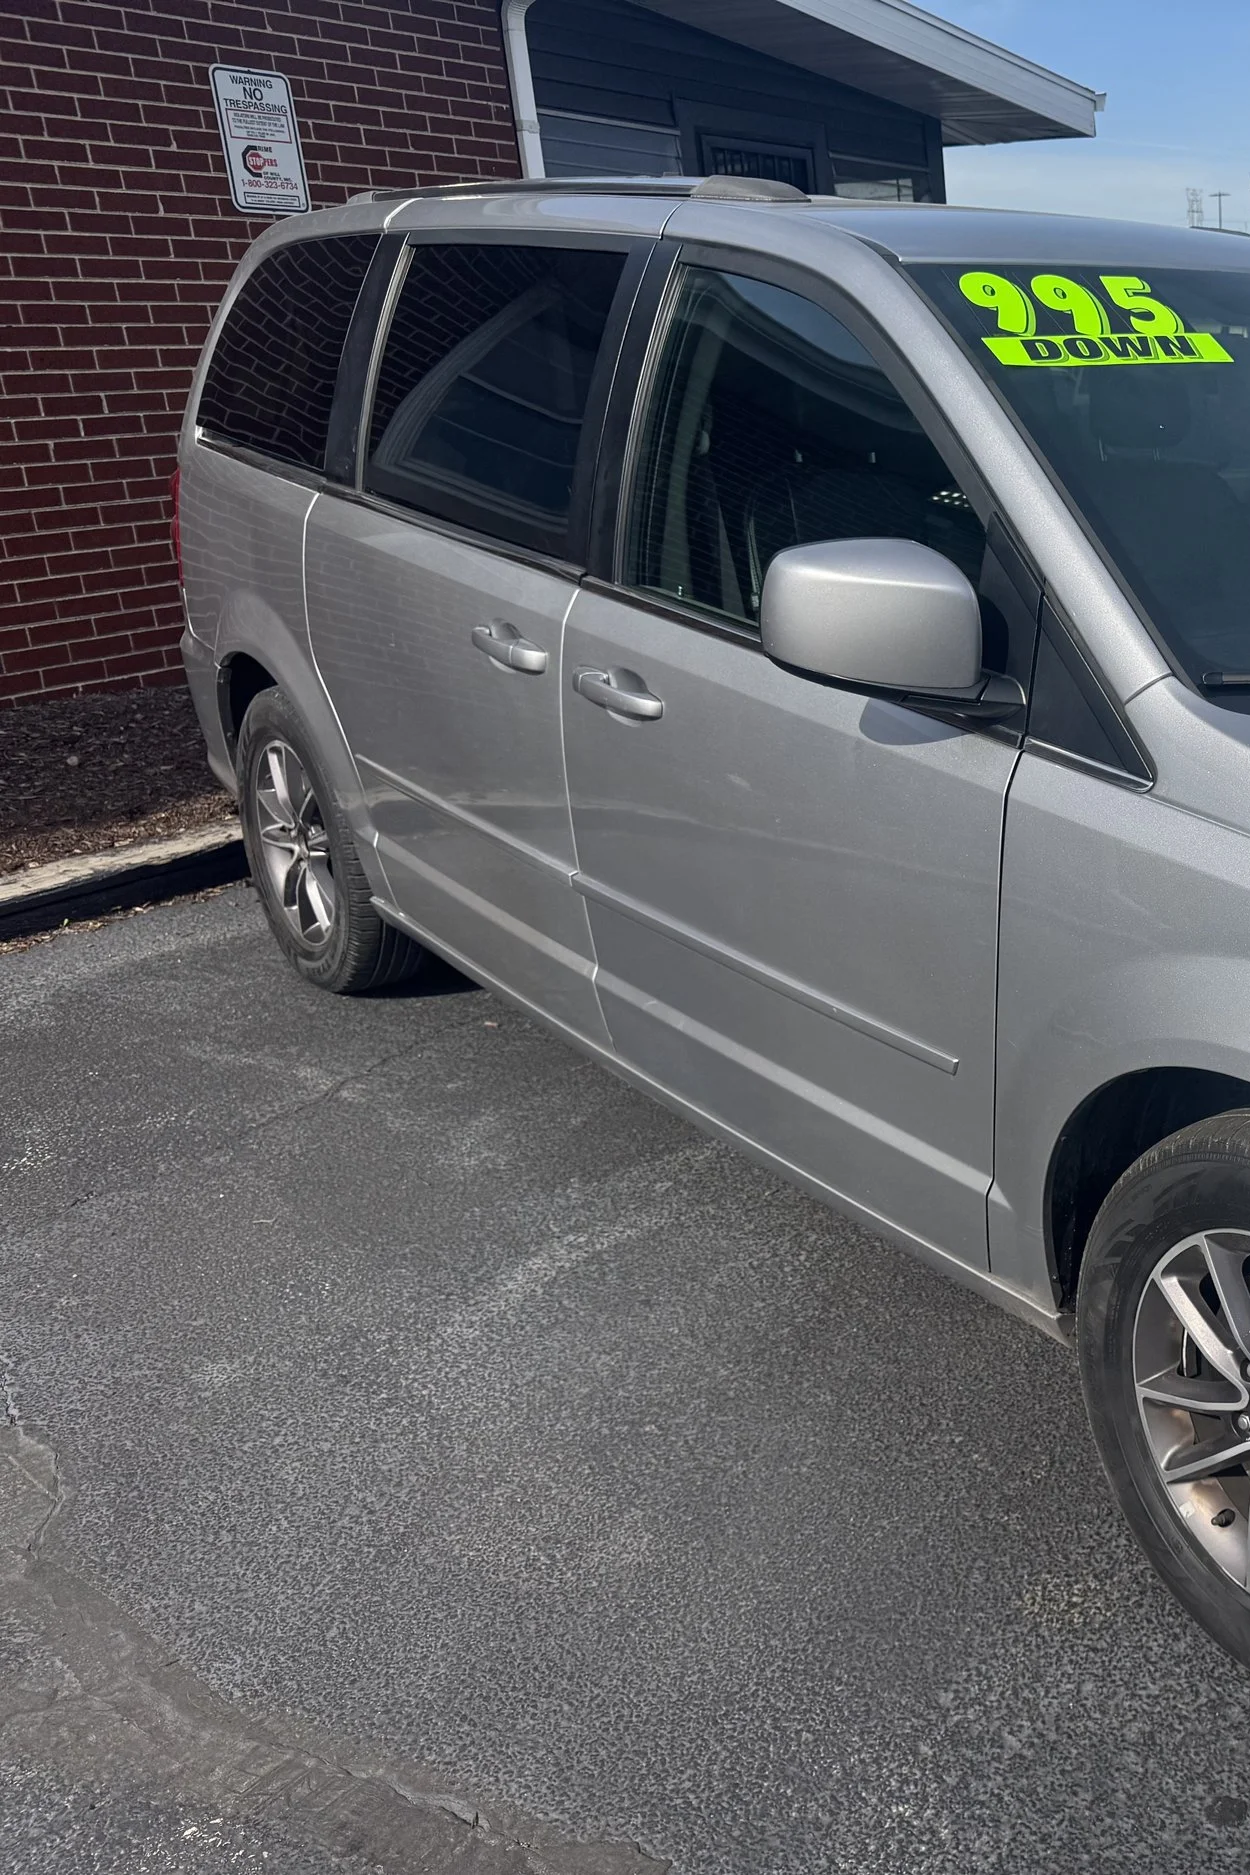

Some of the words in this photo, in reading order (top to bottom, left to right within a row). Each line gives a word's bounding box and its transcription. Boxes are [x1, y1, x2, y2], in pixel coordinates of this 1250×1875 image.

[229, 74, 273, 89] WARNING
[243, 86, 264, 101] NO
[223, 97, 287, 114] TRESPASSING
[242, 179, 298, 190] 1-800-323-6734
[959, 271, 1185, 337] 995
[1020, 336, 1205, 363] DOWN
